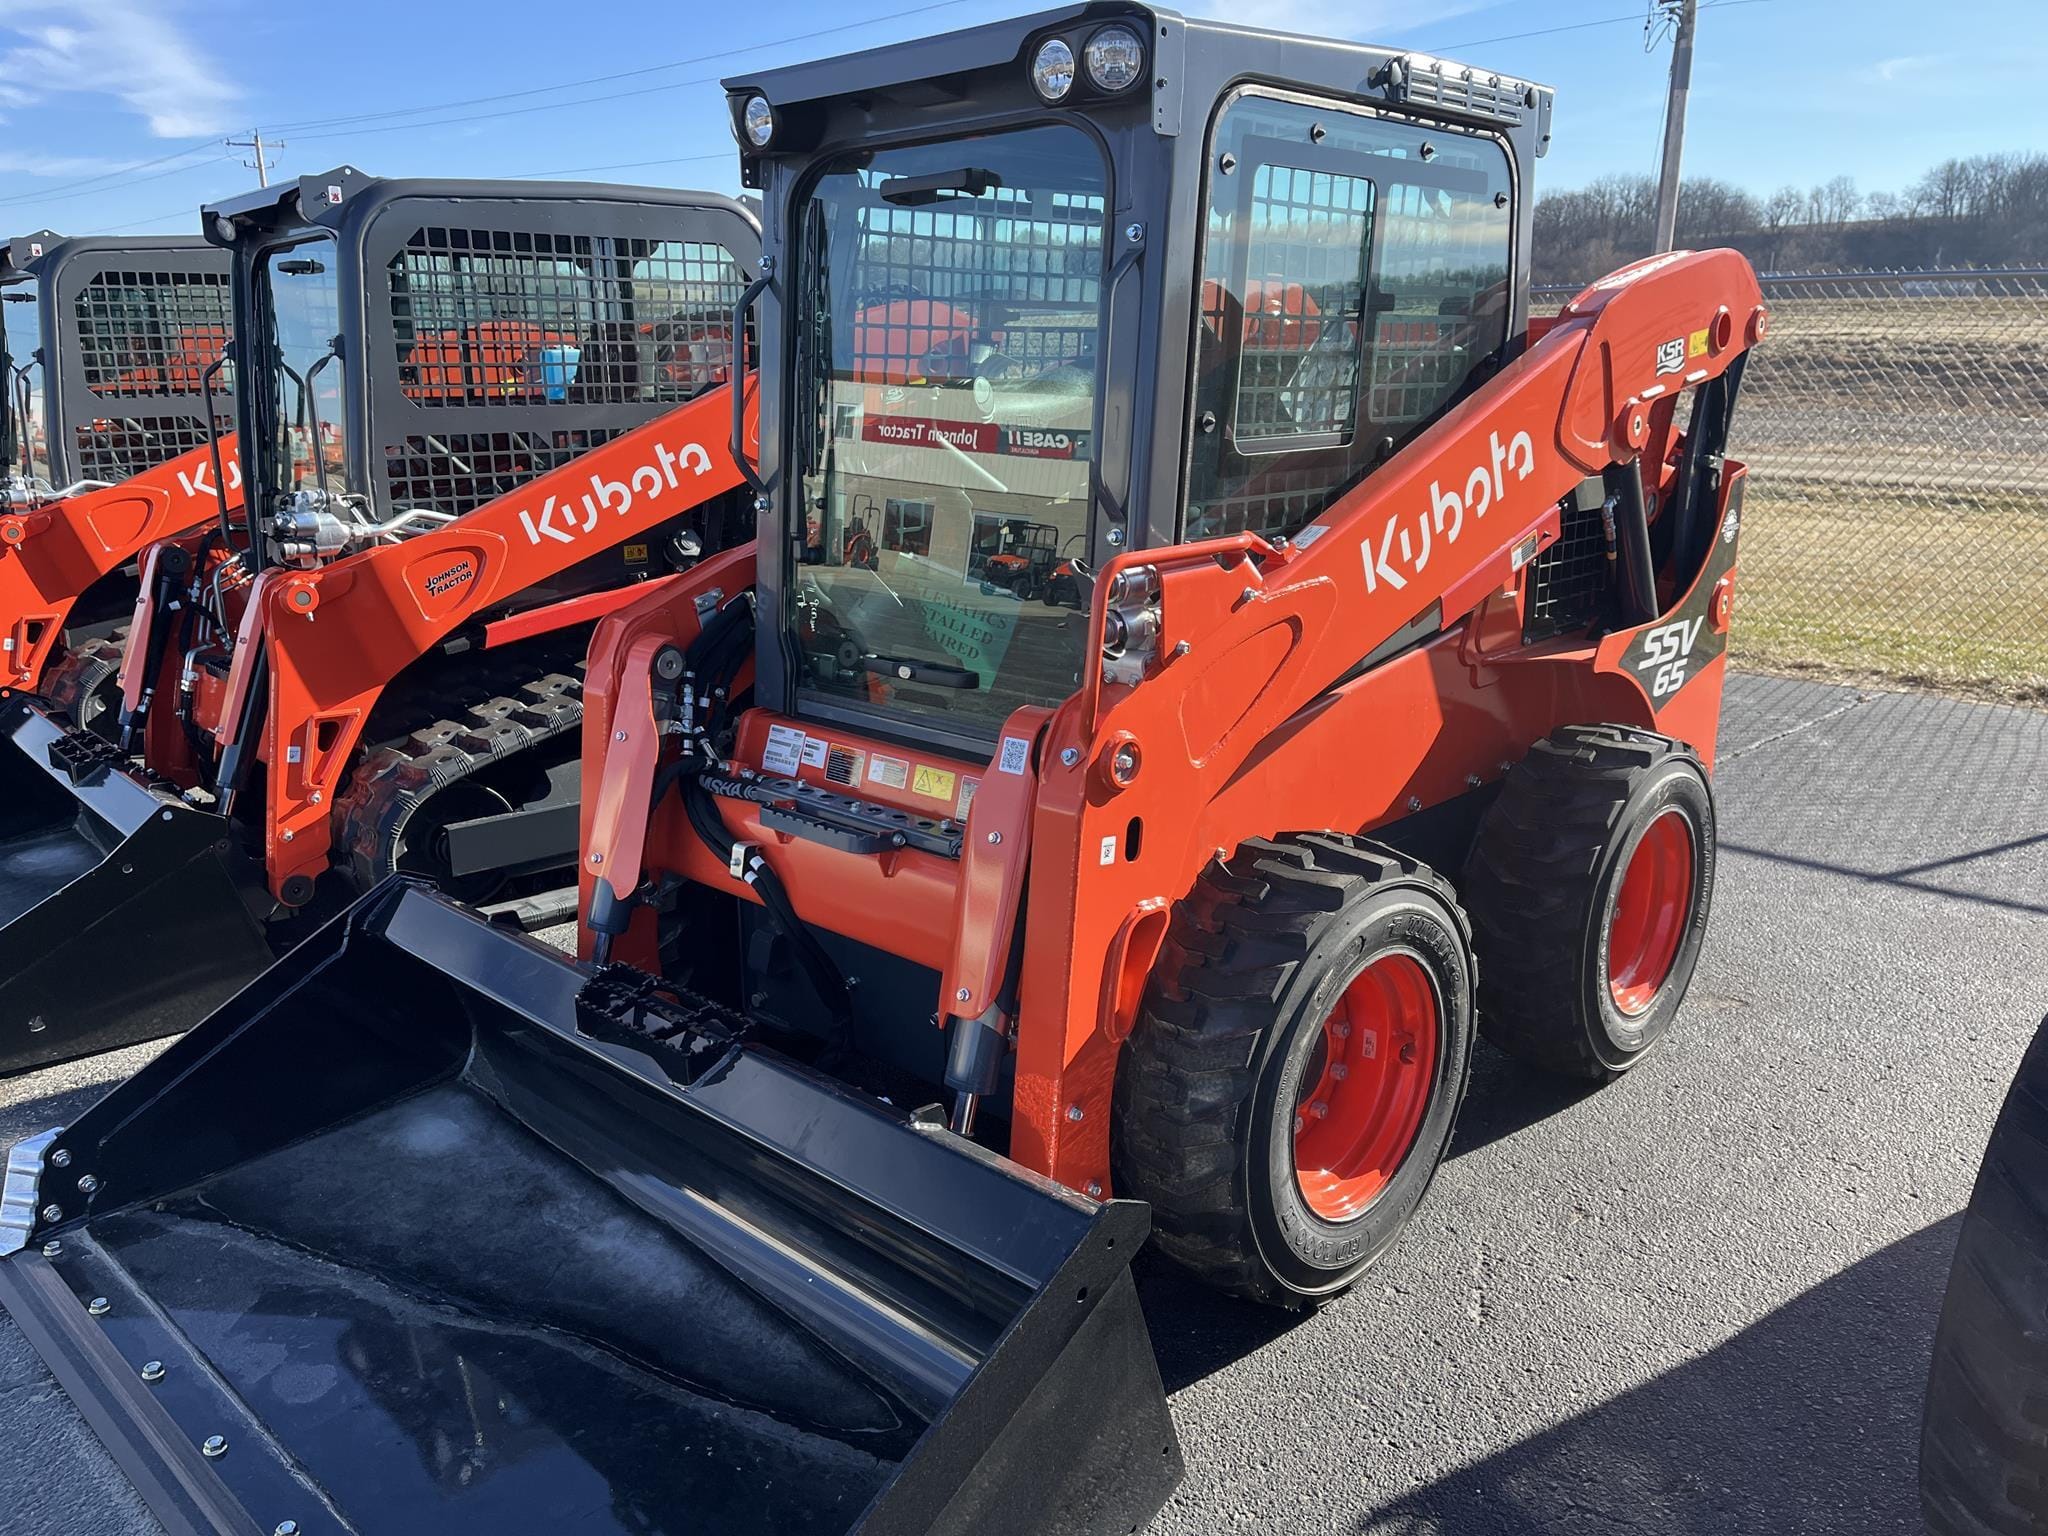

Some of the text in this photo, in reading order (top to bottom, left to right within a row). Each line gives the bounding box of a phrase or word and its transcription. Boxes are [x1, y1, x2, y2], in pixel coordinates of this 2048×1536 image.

[1657, 340, 1685, 364] KSR
[519, 442, 713, 545] Kubota
[1360, 431, 1535, 594] Kubota
[425, 561, 469, 589] JOHNSON
[428, 570, 473, 597] TRACTOR
[921, 624, 980, 660] PAIRED
[1638, 616, 1704, 670] SSV
[1652, 657, 1688, 697] 65
